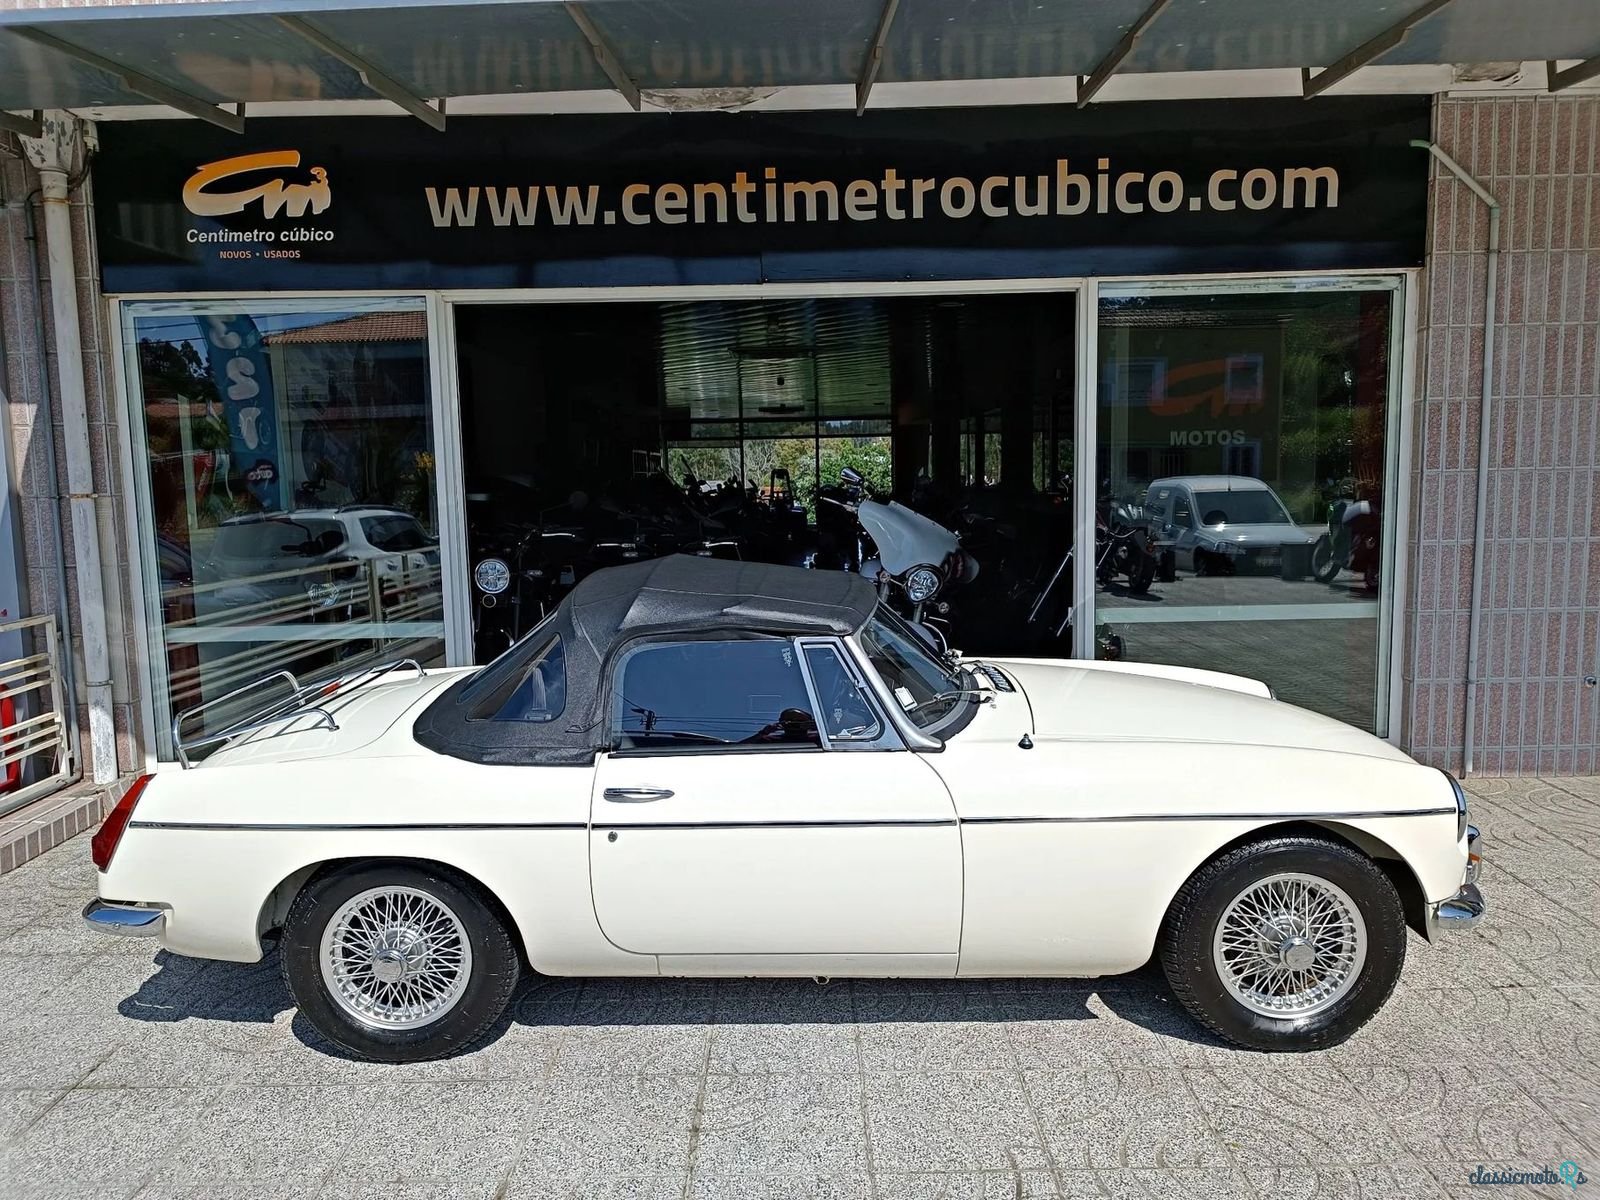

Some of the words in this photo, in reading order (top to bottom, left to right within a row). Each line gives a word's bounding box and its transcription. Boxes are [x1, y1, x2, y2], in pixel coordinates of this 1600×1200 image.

[424, 157, 1339, 228] www.centimetrocubico.com
[186, 229, 275, 243] Centimetro
[280, 227, 334, 242] cúbico
[219, 250, 252, 259] NOVOS
[263, 250, 301, 259] USADOS
[1169, 430, 1247, 446] MOTOS
